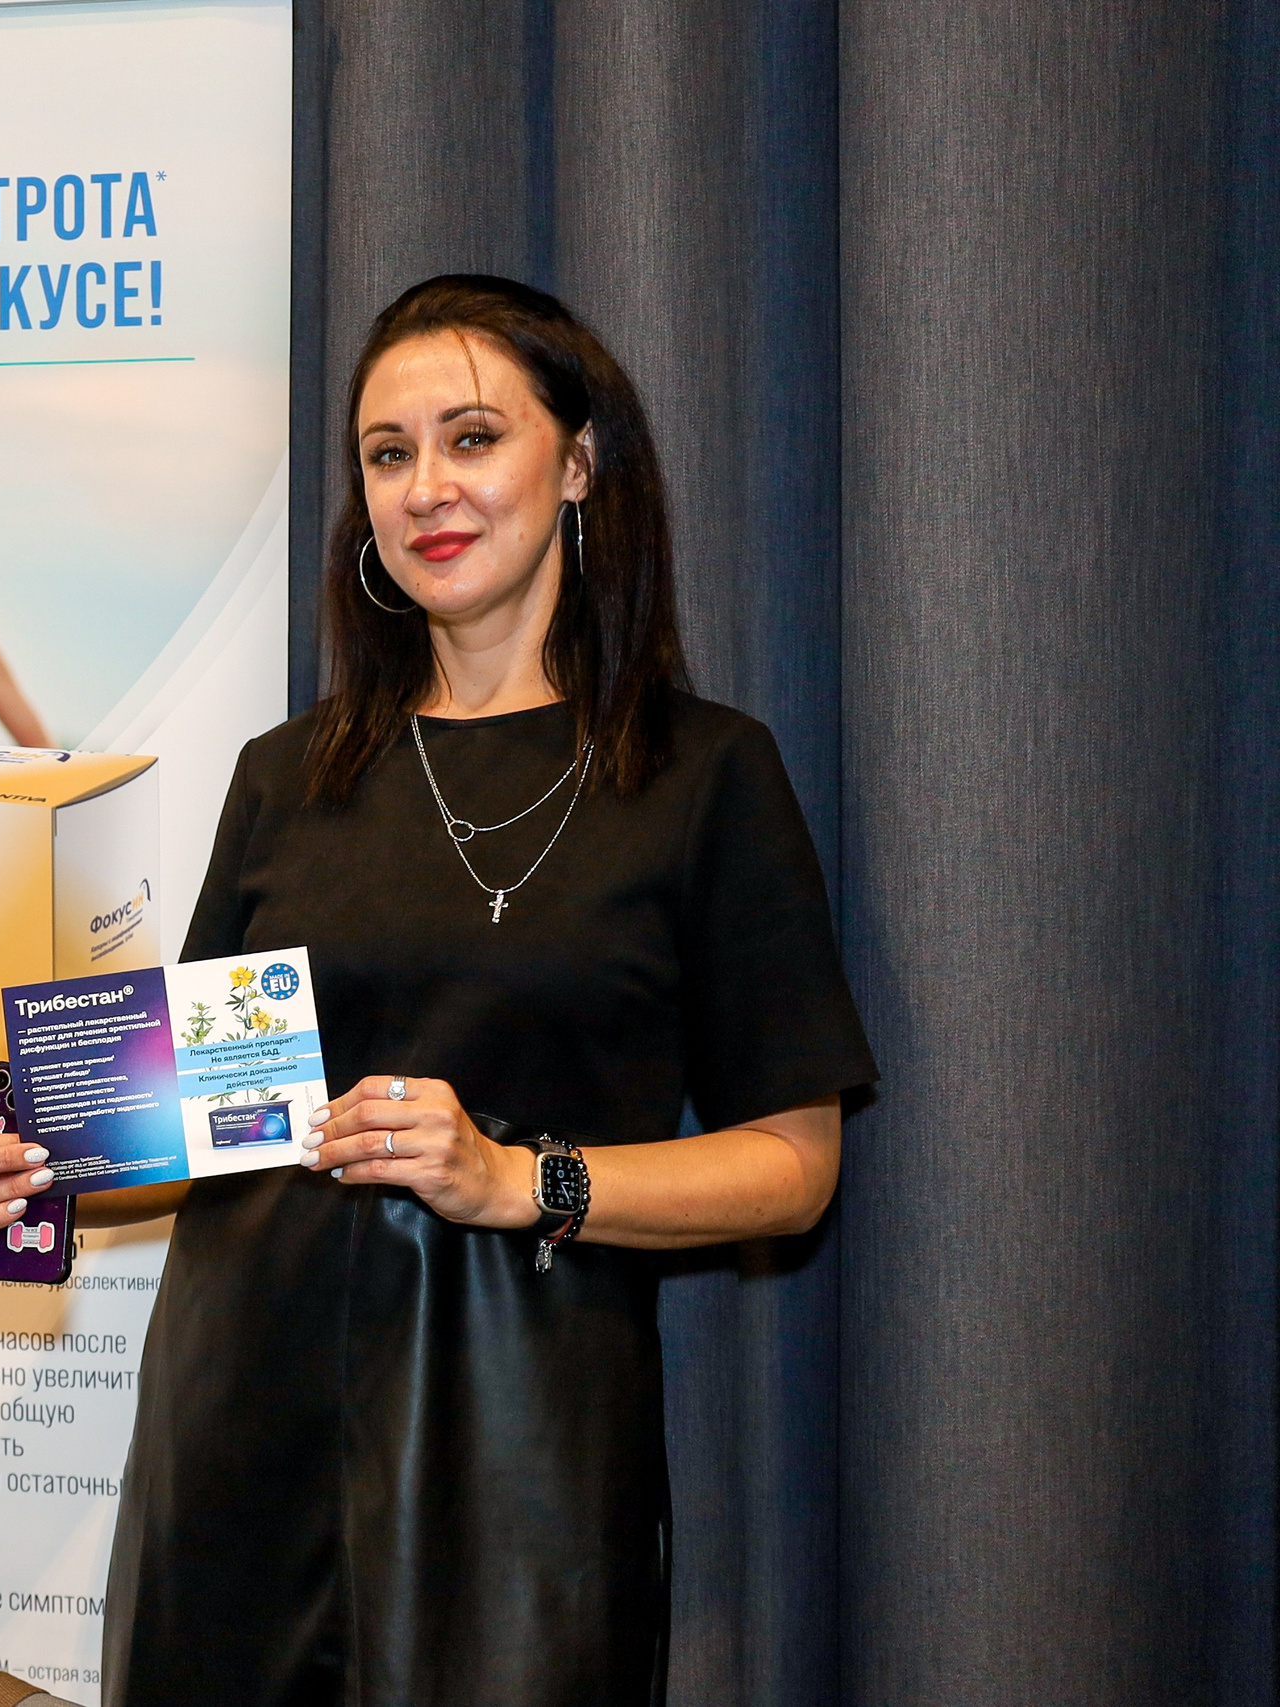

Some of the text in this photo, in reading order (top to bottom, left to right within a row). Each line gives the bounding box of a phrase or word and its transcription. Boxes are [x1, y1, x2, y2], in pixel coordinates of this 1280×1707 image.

[270, 977, 291, 993] EU
[15, 985, 134, 1019] Трибестан®
[19, 1020, 161, 1045] препарат для лечения эректильной
[27, 1011, 147, 1035] растительный лекарственный
[20, 1042, 70, 1055] дисфункции
[78, 1036, 121, 1046] бесплодия
[190, 1041, 253, 1056] Лекарственный
[224, 1052, 260, 1062] является
[262, 1048, 281, 1056] БАД.
[199, 1064, 298, 1082] Клинически доказанное
[62, 1333, 126, 1355] после
[32, 1367, 140, 1392] увеличит
[0, 1398, 75, 1427] общую
[7, 1474, 122, 1497] остаточны
[9, 1591, 106, 1617] симптом
[28, 1666, 78, 1683] острая
